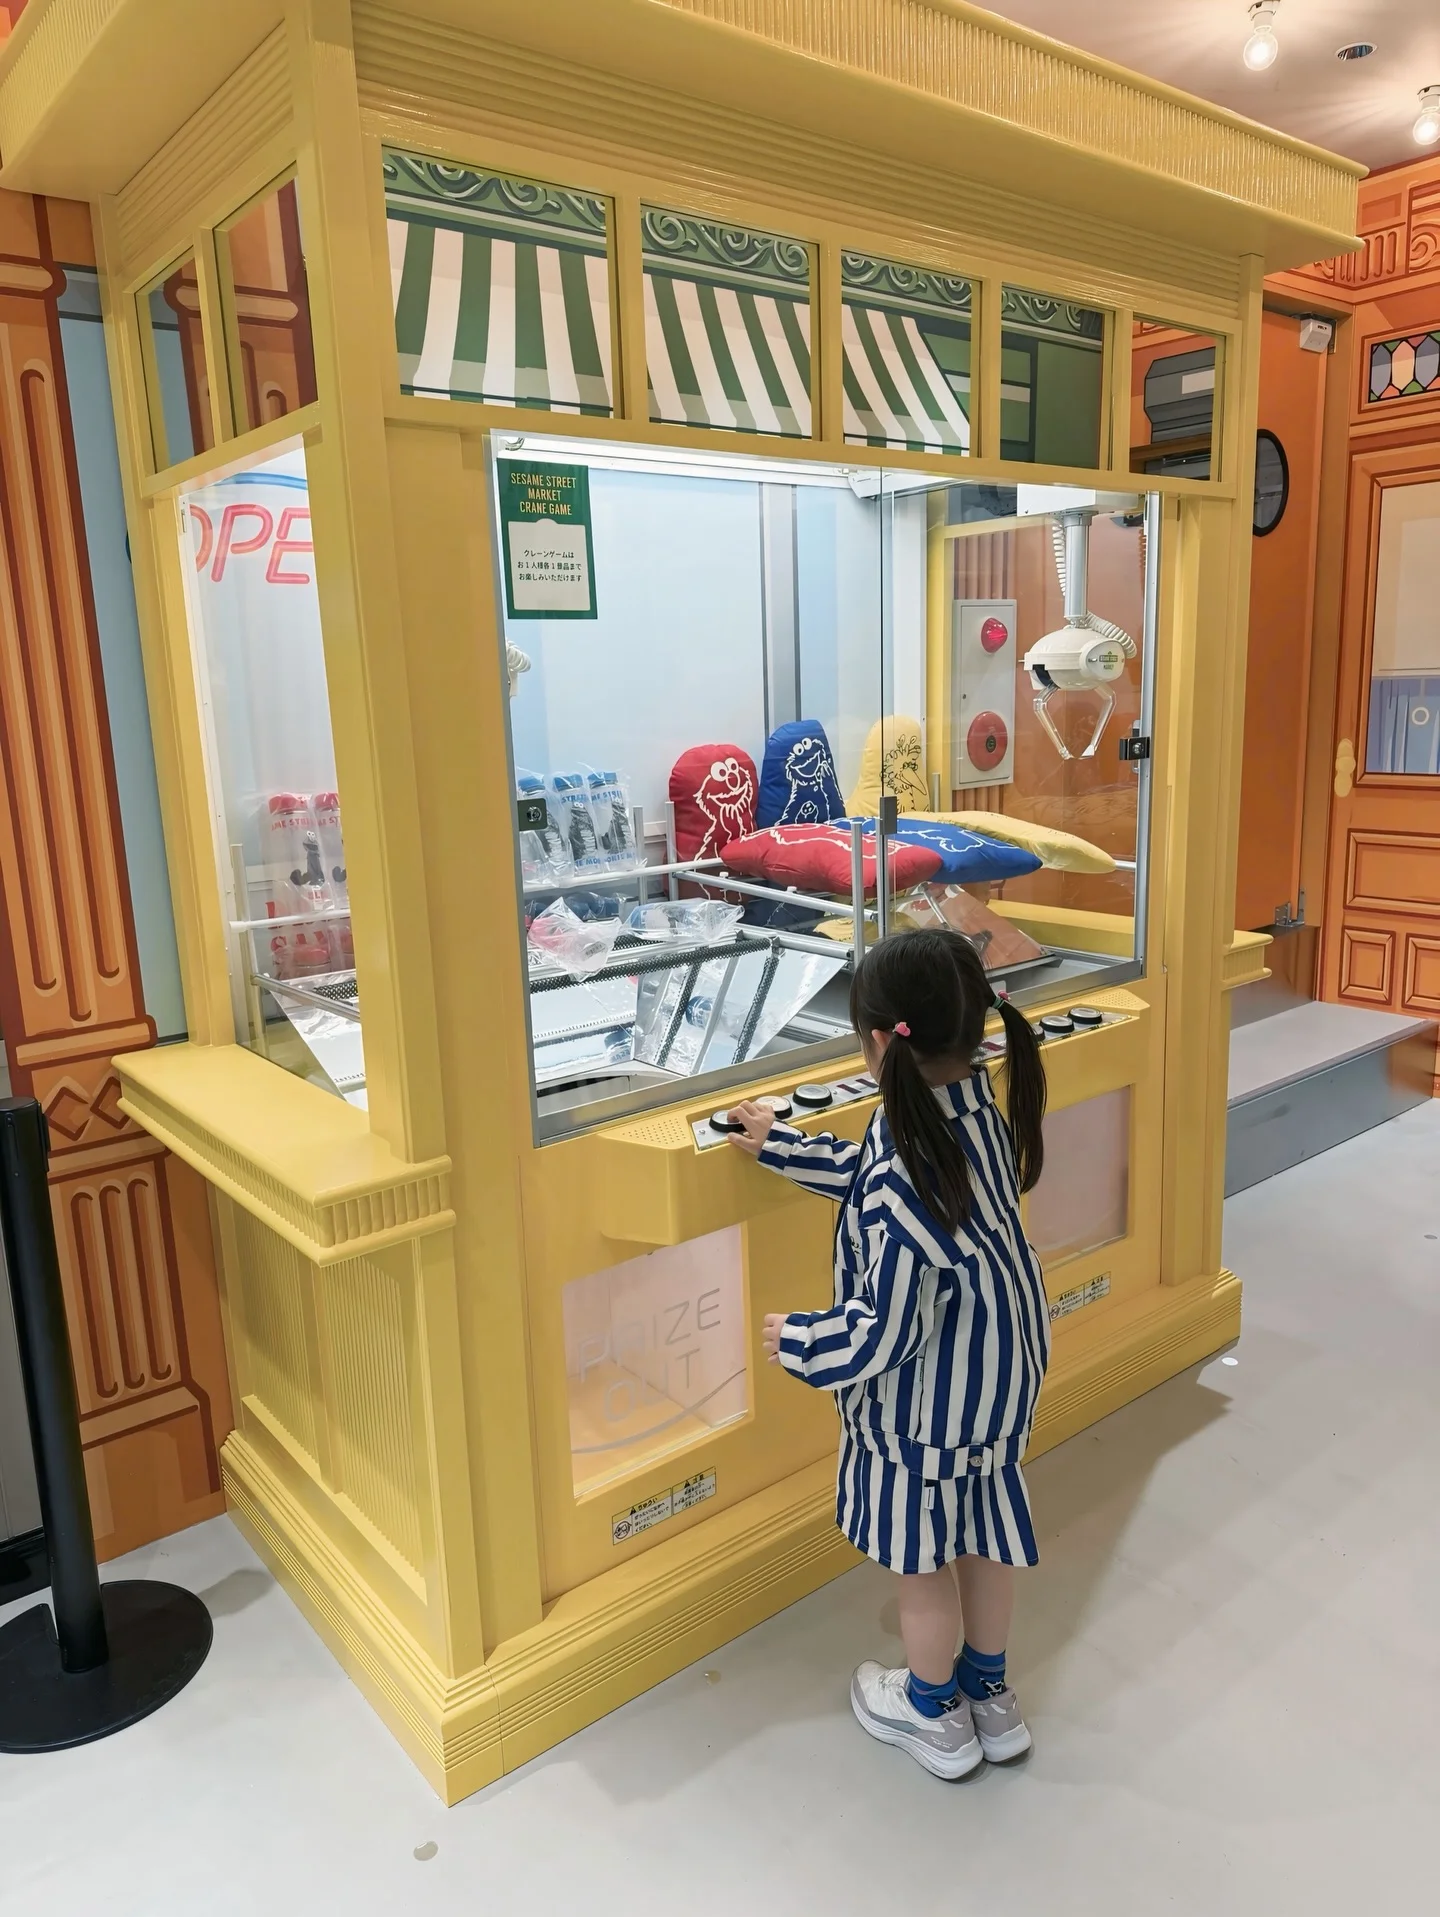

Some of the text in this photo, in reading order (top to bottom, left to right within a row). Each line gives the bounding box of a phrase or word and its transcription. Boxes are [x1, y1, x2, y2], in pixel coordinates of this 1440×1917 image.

[511, 472, 576, 489] SESAME STREET
[528, 488, 561, 501] MARKET
[519, 501, 572, 515] CRANE GAME
[523, 549, 574, 559] クレーンゲームは
[519, 573, 582, 582] お楽しみいただけます
[578, 1287, 721, 1383] PRIZE
